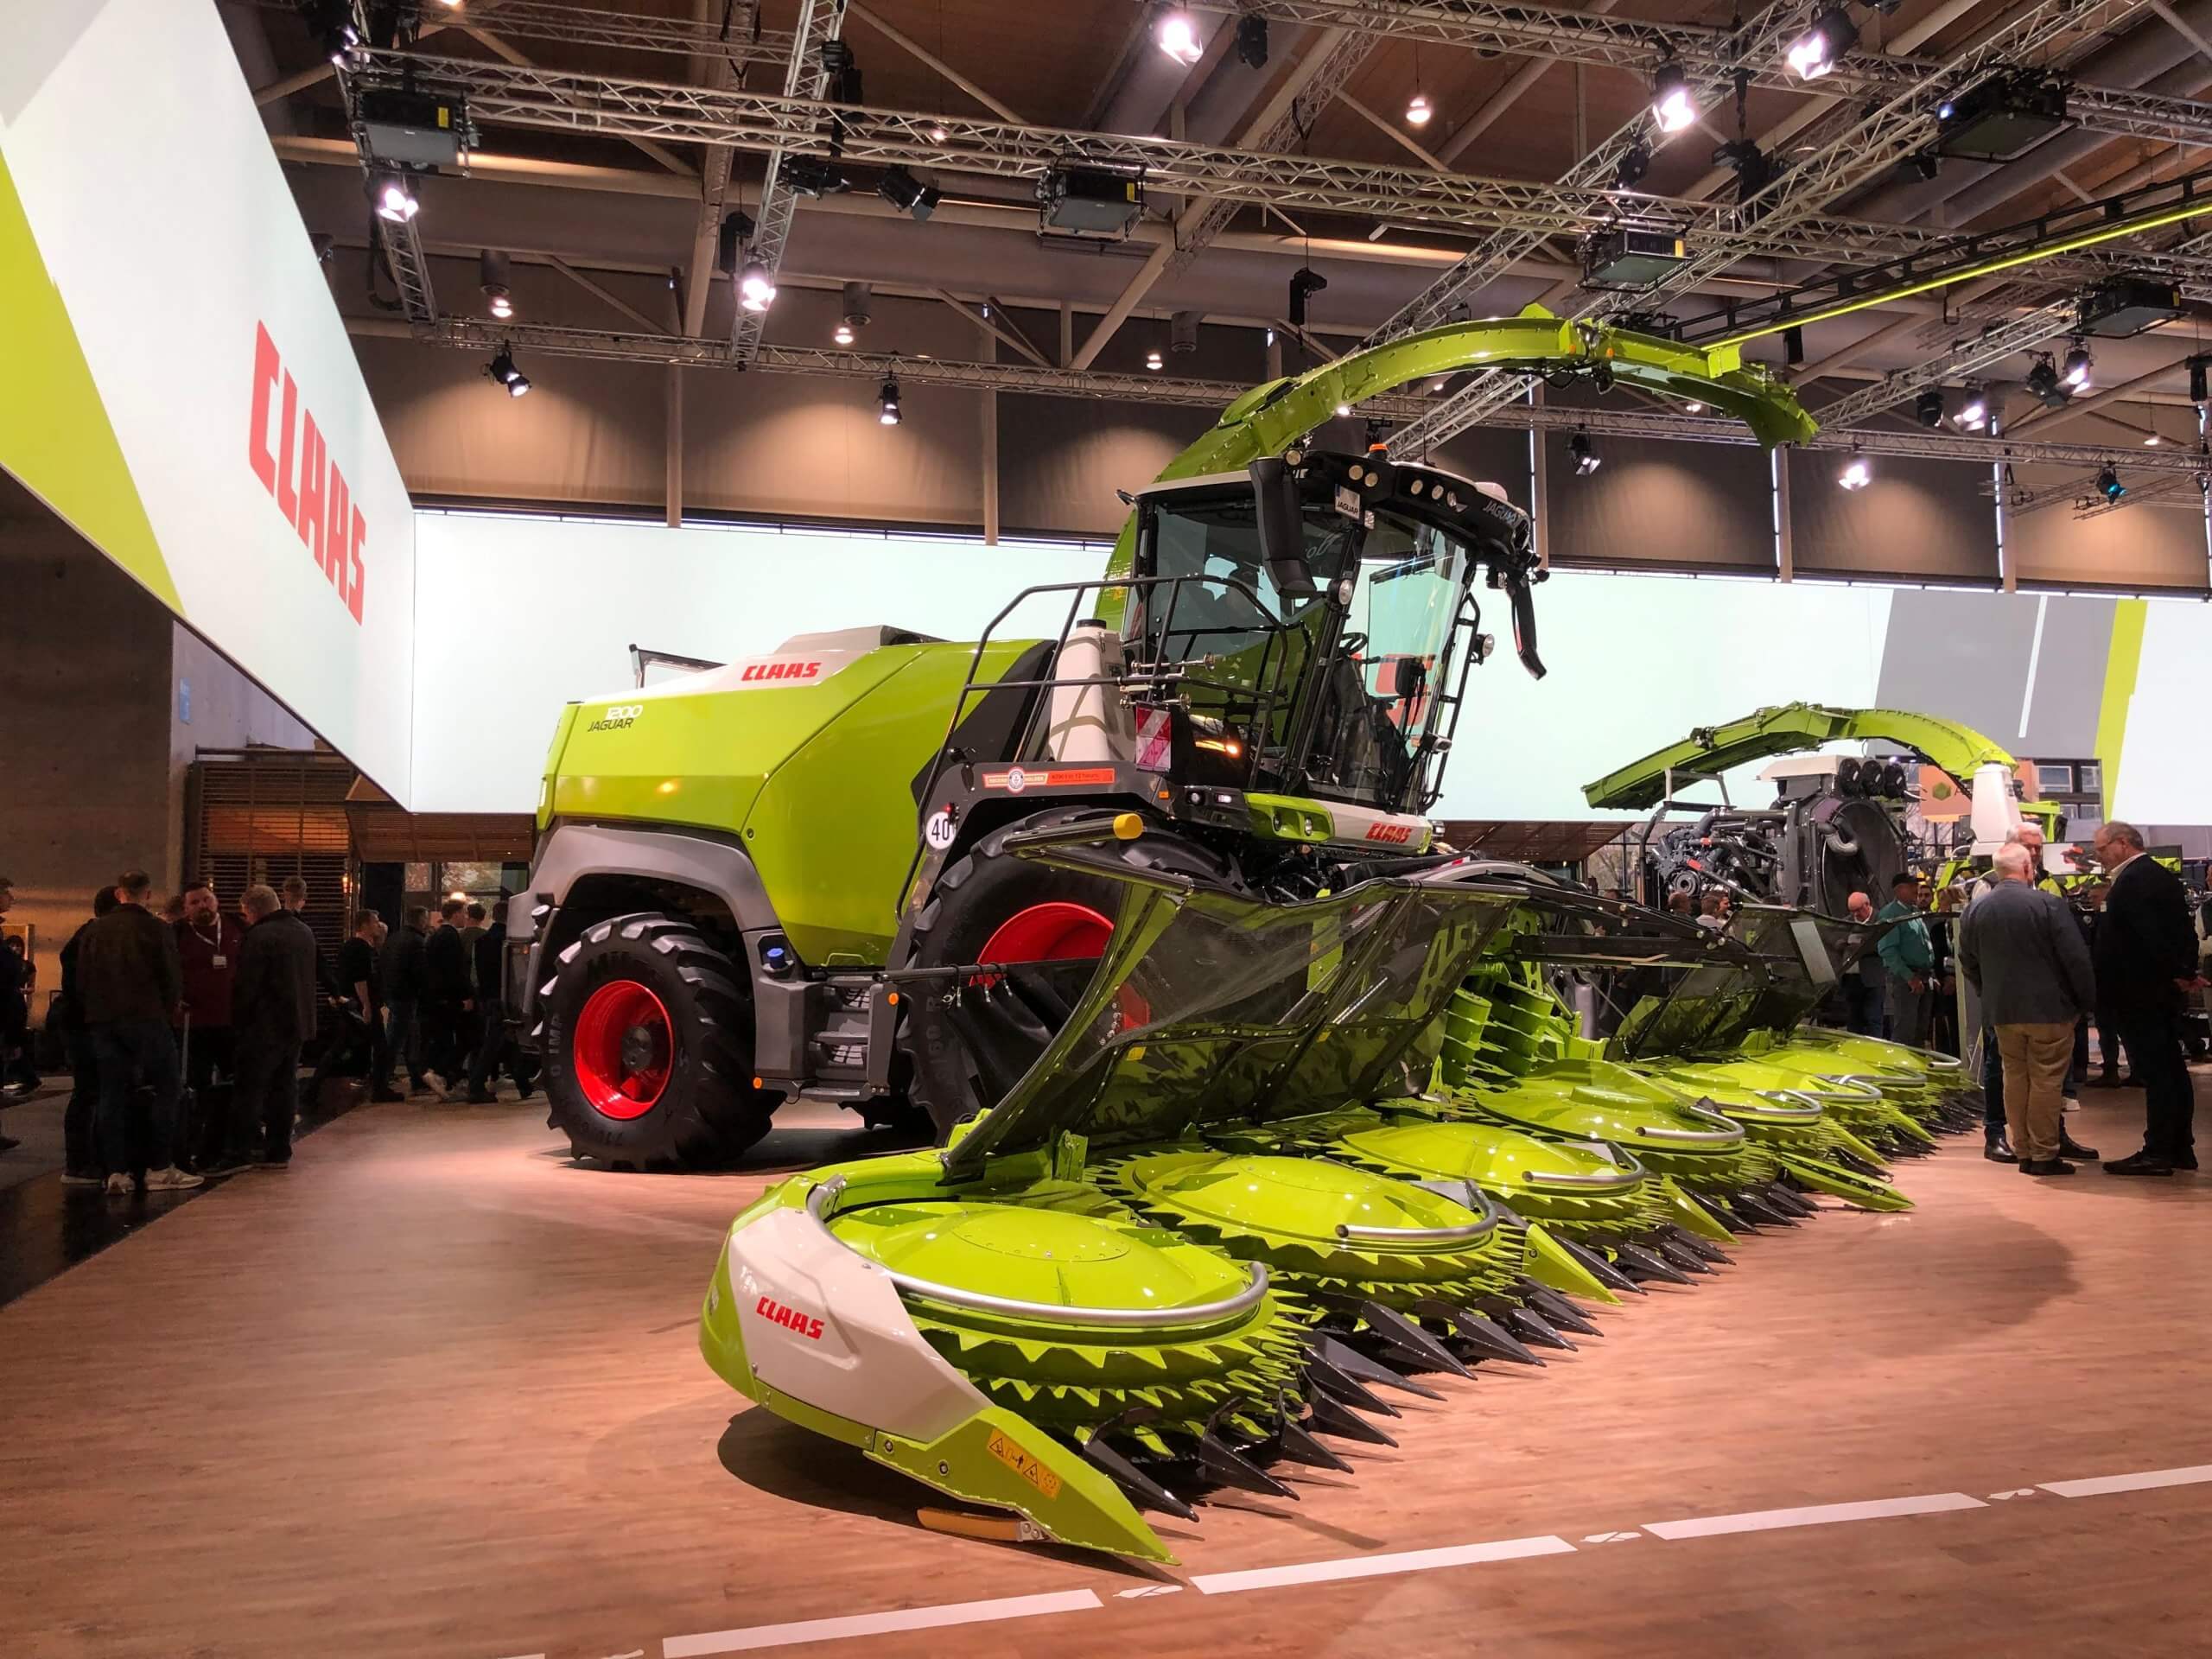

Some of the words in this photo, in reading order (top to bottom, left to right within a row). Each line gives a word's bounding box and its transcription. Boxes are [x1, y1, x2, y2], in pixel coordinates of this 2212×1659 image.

[248, 318, 366, 627] CLAAS
[741, 661, 822, 682] CLAAS
[605, 704, 644, 721] 1200
[587, 717, 634, 733] JAGUAR
[931, 817, 950, 842] 40
[1366, 823, 1413, 844] CLAAS
[756, 1295, 825, 1340] CLAAS
